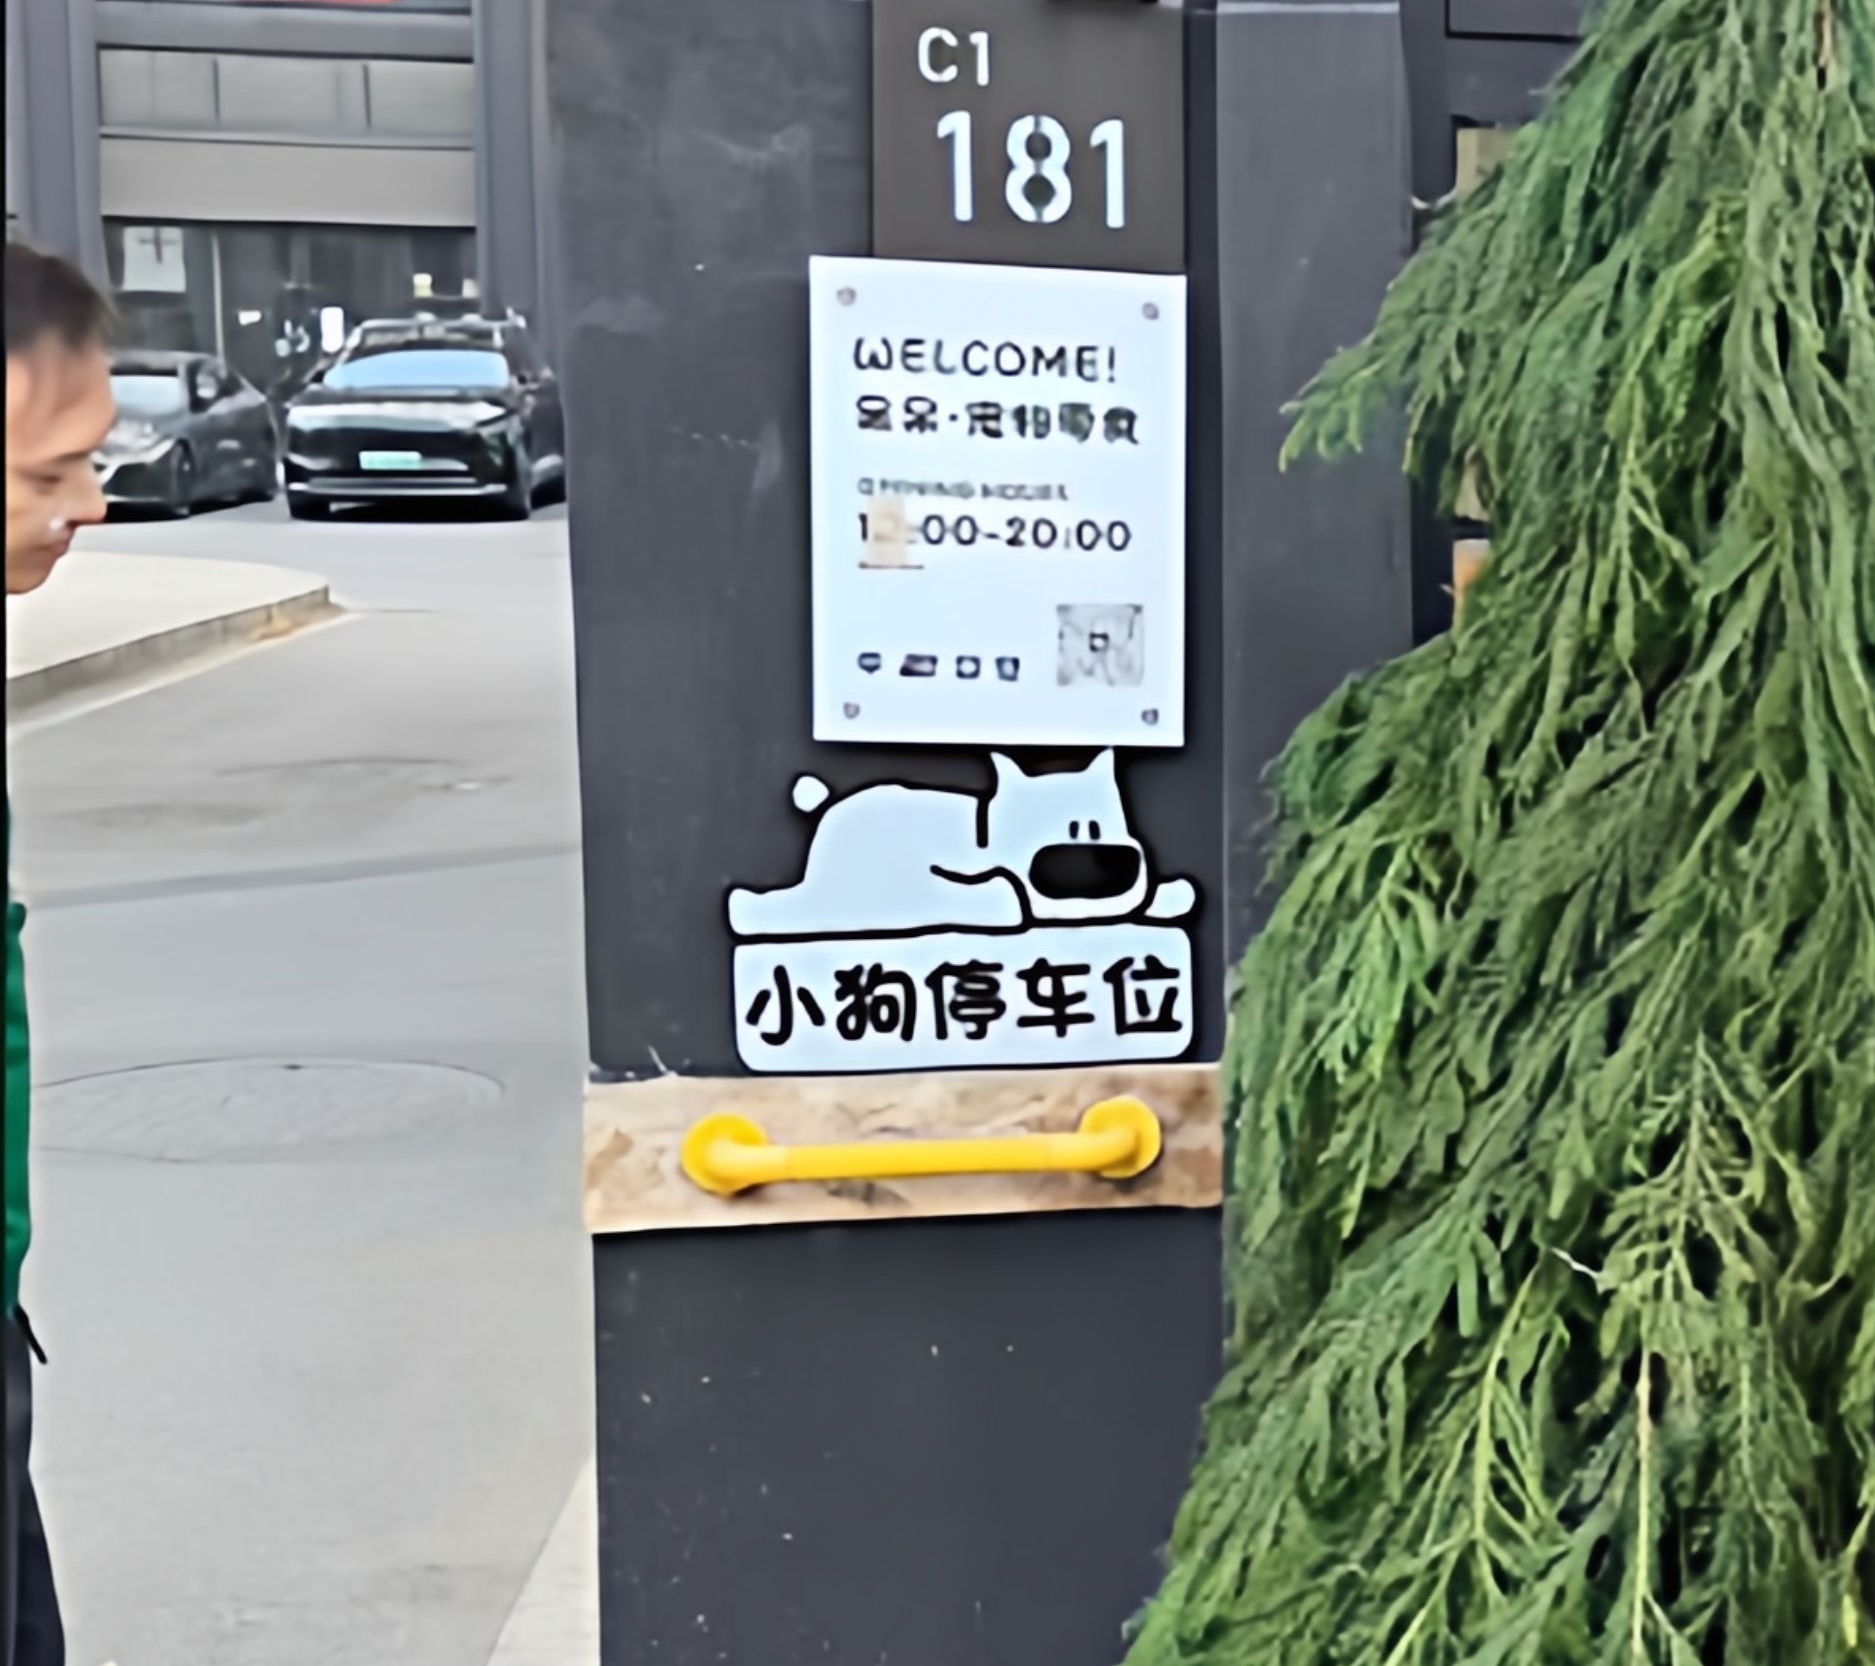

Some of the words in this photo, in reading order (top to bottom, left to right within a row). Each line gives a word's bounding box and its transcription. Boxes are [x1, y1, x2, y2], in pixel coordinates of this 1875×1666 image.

[917, 27, 992, 87] C1
[936, 109, 1127, 230] 181
[853, 336, 1116, 383] WELCOME!
[745, 954, 1183, 1046] 小狗停车位
